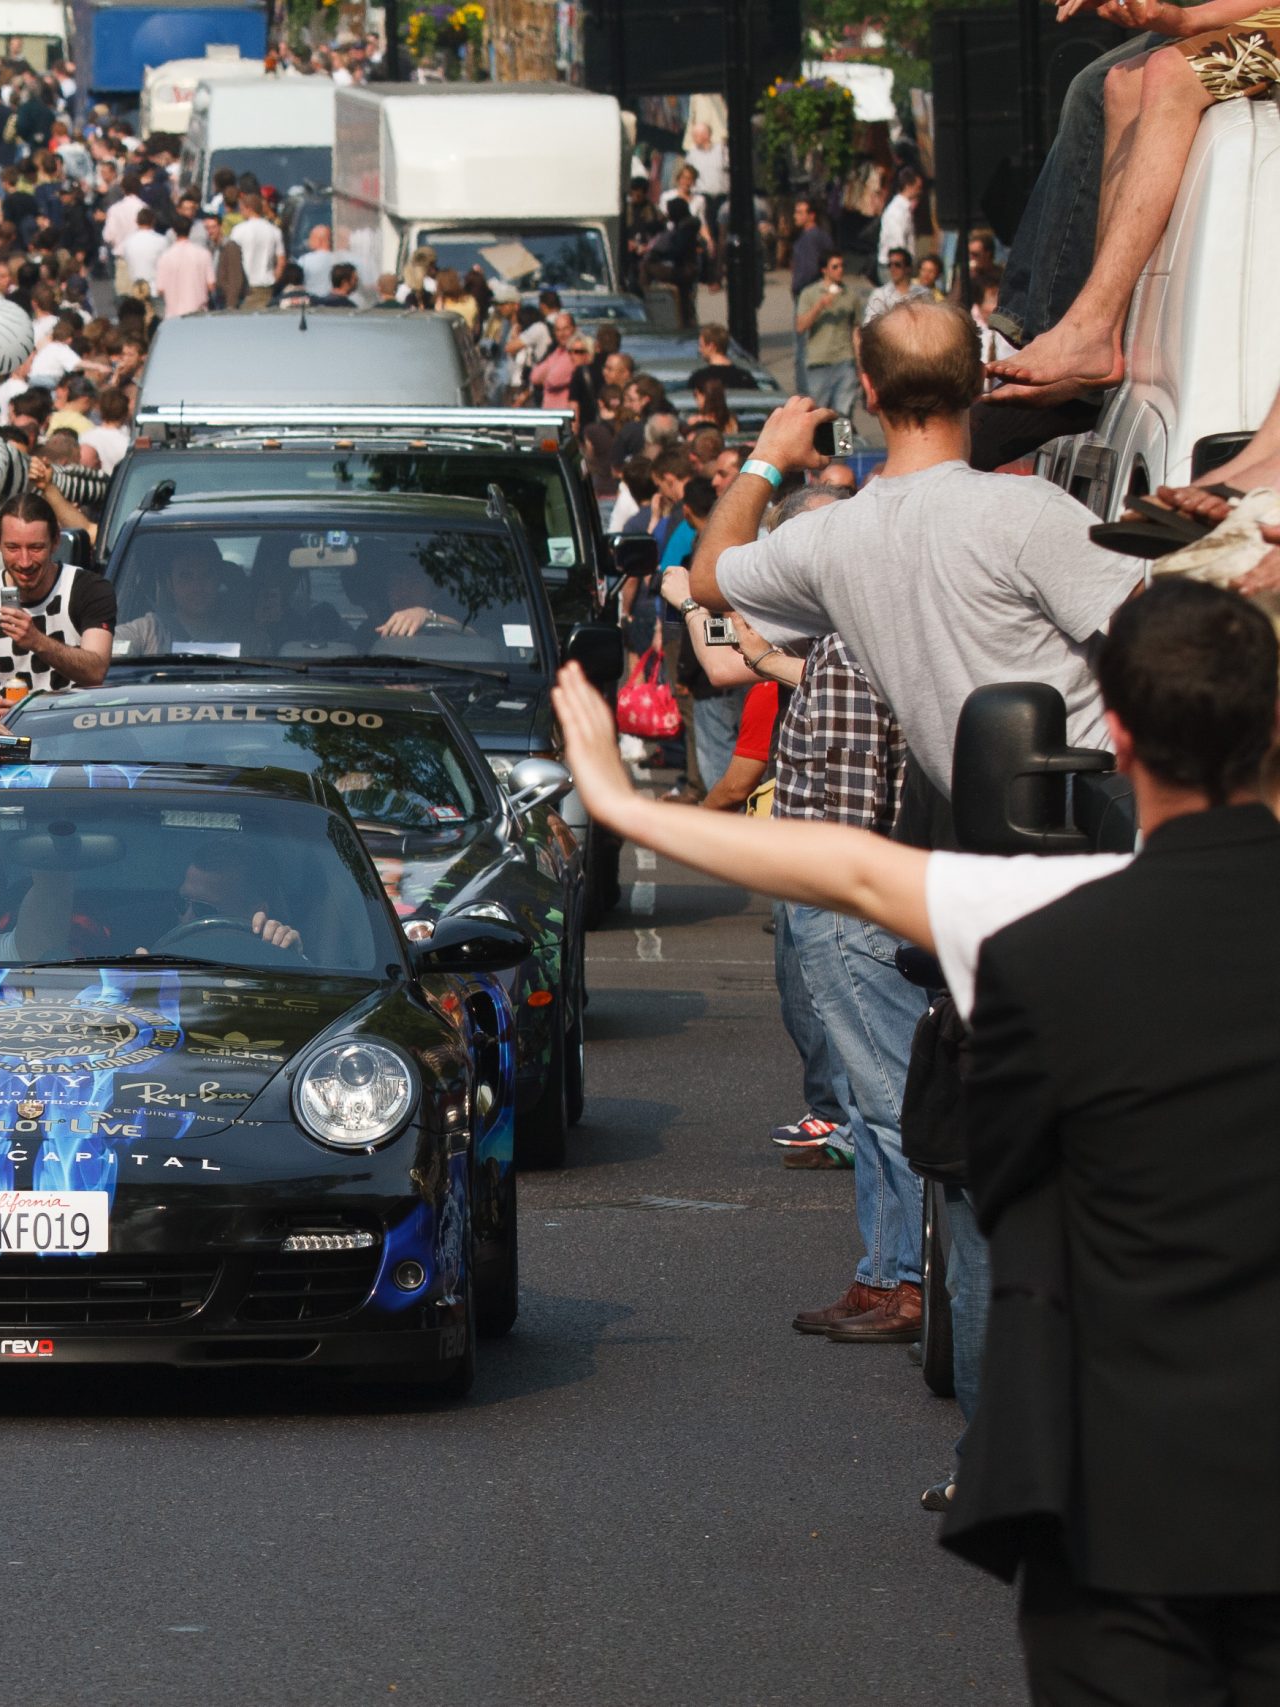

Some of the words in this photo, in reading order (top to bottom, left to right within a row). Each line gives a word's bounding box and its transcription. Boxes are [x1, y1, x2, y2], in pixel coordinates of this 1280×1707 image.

[72, 705, 267, 730] GUMBALL
[276, 706, 384, 729] 3000
[10, 1063, 74, 1073] ASIA
[80, 1046, 164, 1072] LONDON
[187, 1047, 284, 1063] adidas
[120, 1081, 252, 1108] Ray-Ban
[113, 1107, 177, 1118] GENUINE
[183, 1113, 225, 1123] SINCE
[0, 1339, 54, 1354] revo
